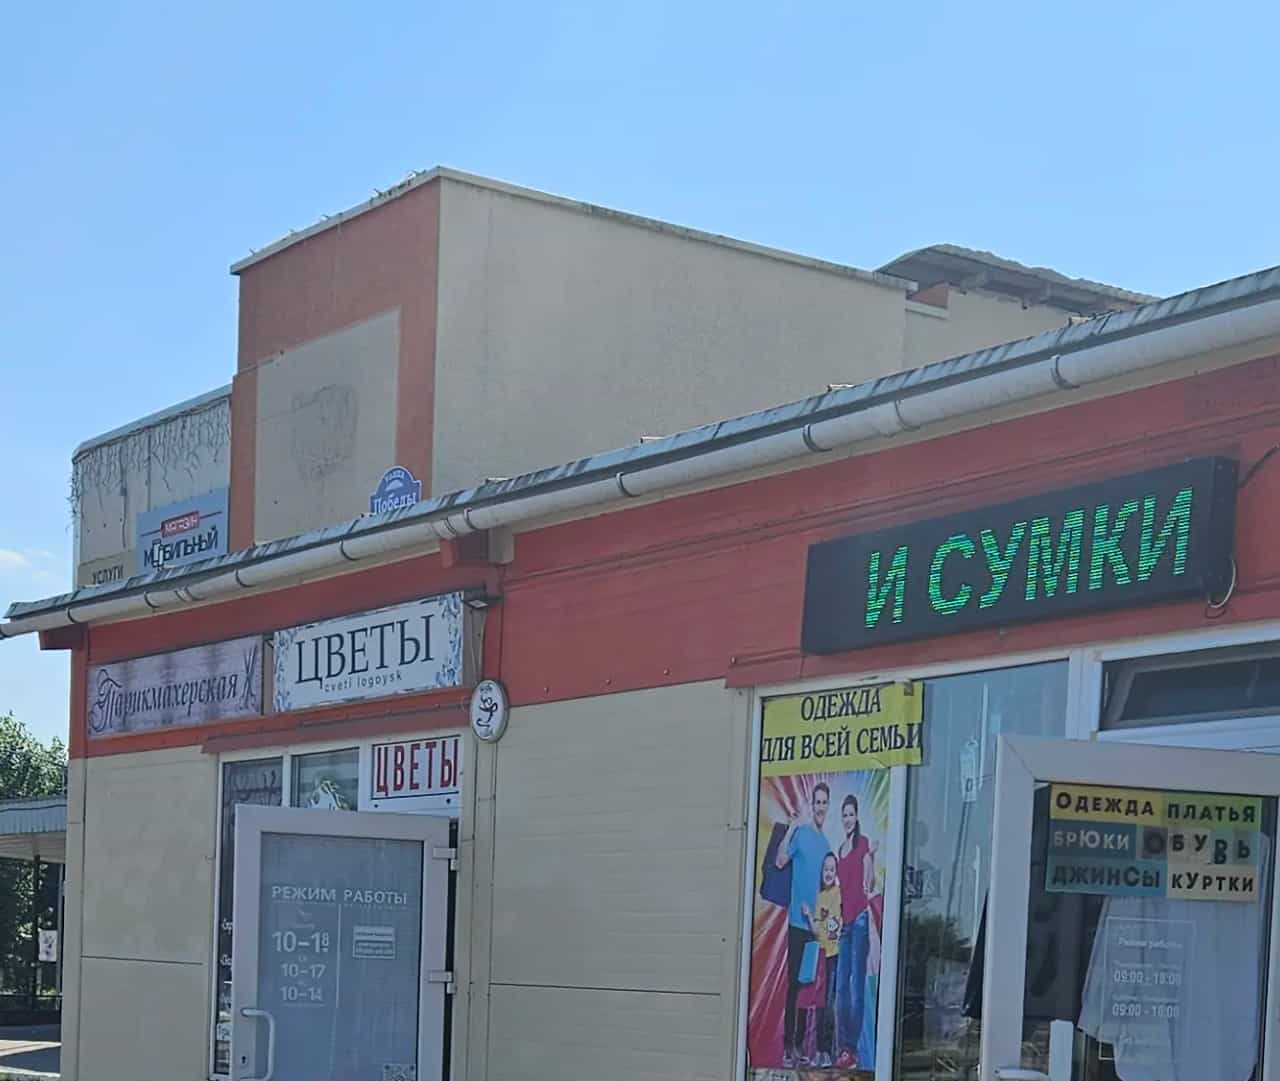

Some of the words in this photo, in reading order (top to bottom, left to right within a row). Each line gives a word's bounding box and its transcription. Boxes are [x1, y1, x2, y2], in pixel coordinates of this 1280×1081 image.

[865, 546, 909, 630] И
[928, 487, 1194, 615] СУМКИ
[295, 614, 435, 689] ЦВЕТЫ
[88, 667, 238, 734] Парикмахерская
[801, 688, 882, 721] ОДЕЖДА
[800, 726, 851, 760] ВСЕЙ
[857, 722, 923, 755] СЕМЬИ
[376, 739, 459, 796] ЦВЕТЫ
[1056, 792, 1155, 816] ОДЕЖДА
[1167, 803, 1256, 823] ПЛАТЬЯ
[1053, 830, 1130, 850] БРЮКИ
[1052, 865, 1160, 888] ДЖИНСЫ
[1172, 871, 1254, 893] КУРТКИ
[272, 885, 336, 900] РЕЖИМ
[343, 889, 407, 905] РАБОТЫ
